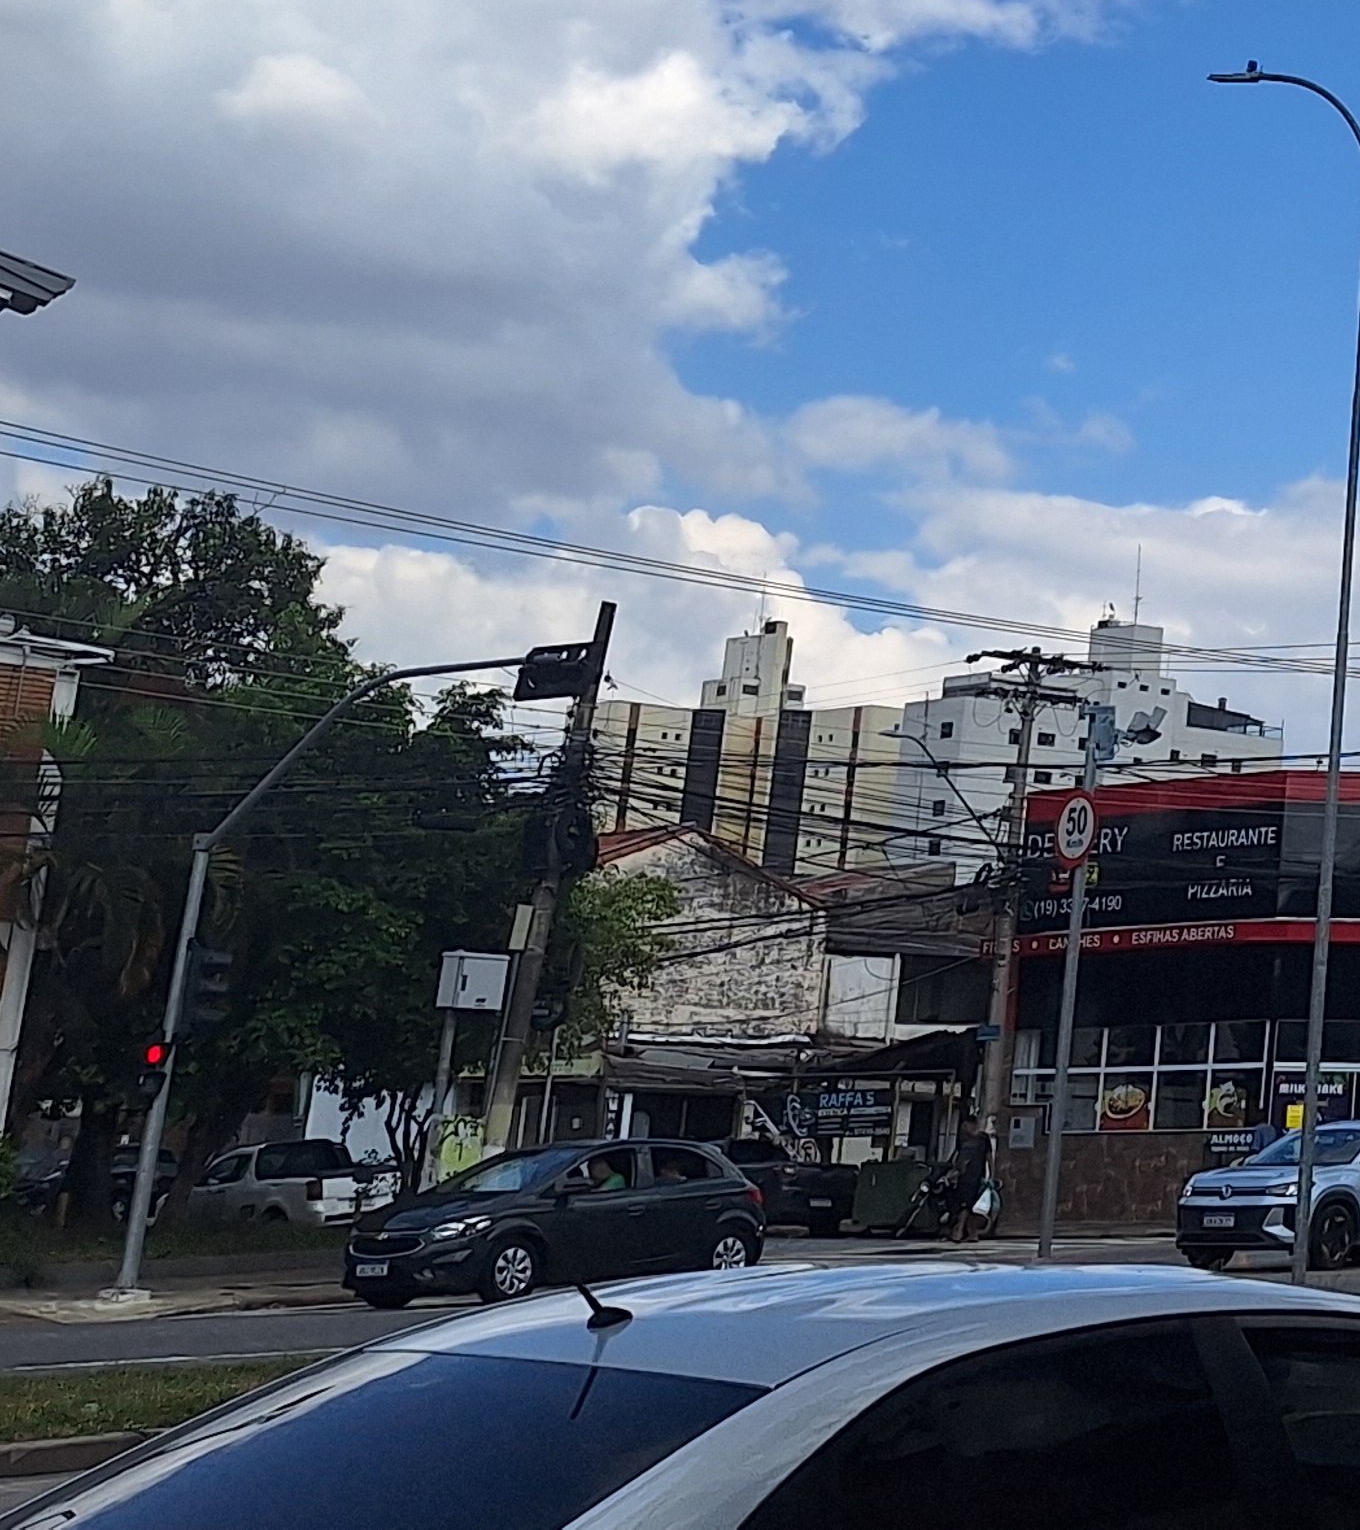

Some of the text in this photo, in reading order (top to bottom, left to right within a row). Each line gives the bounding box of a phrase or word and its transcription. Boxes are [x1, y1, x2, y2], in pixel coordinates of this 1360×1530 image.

[1066, 805, 1088, 837] 50
[1027, 826, 1128, 858] DERY
[1172, 826, 1278, 852] RESTAURANTE
[1187, 878, 1253, 900] PIZZARIA
[1059, 895, 1123, 913] 337-4190
[1048, 934, 1101, 950] LANHES
[1131, 925, 1235, 945] ESFIHAS ABERTAS
[819, 1091, 875, 1108] RAFFAS
[1210, 1133, 1253, 1145] ALMOÇO
